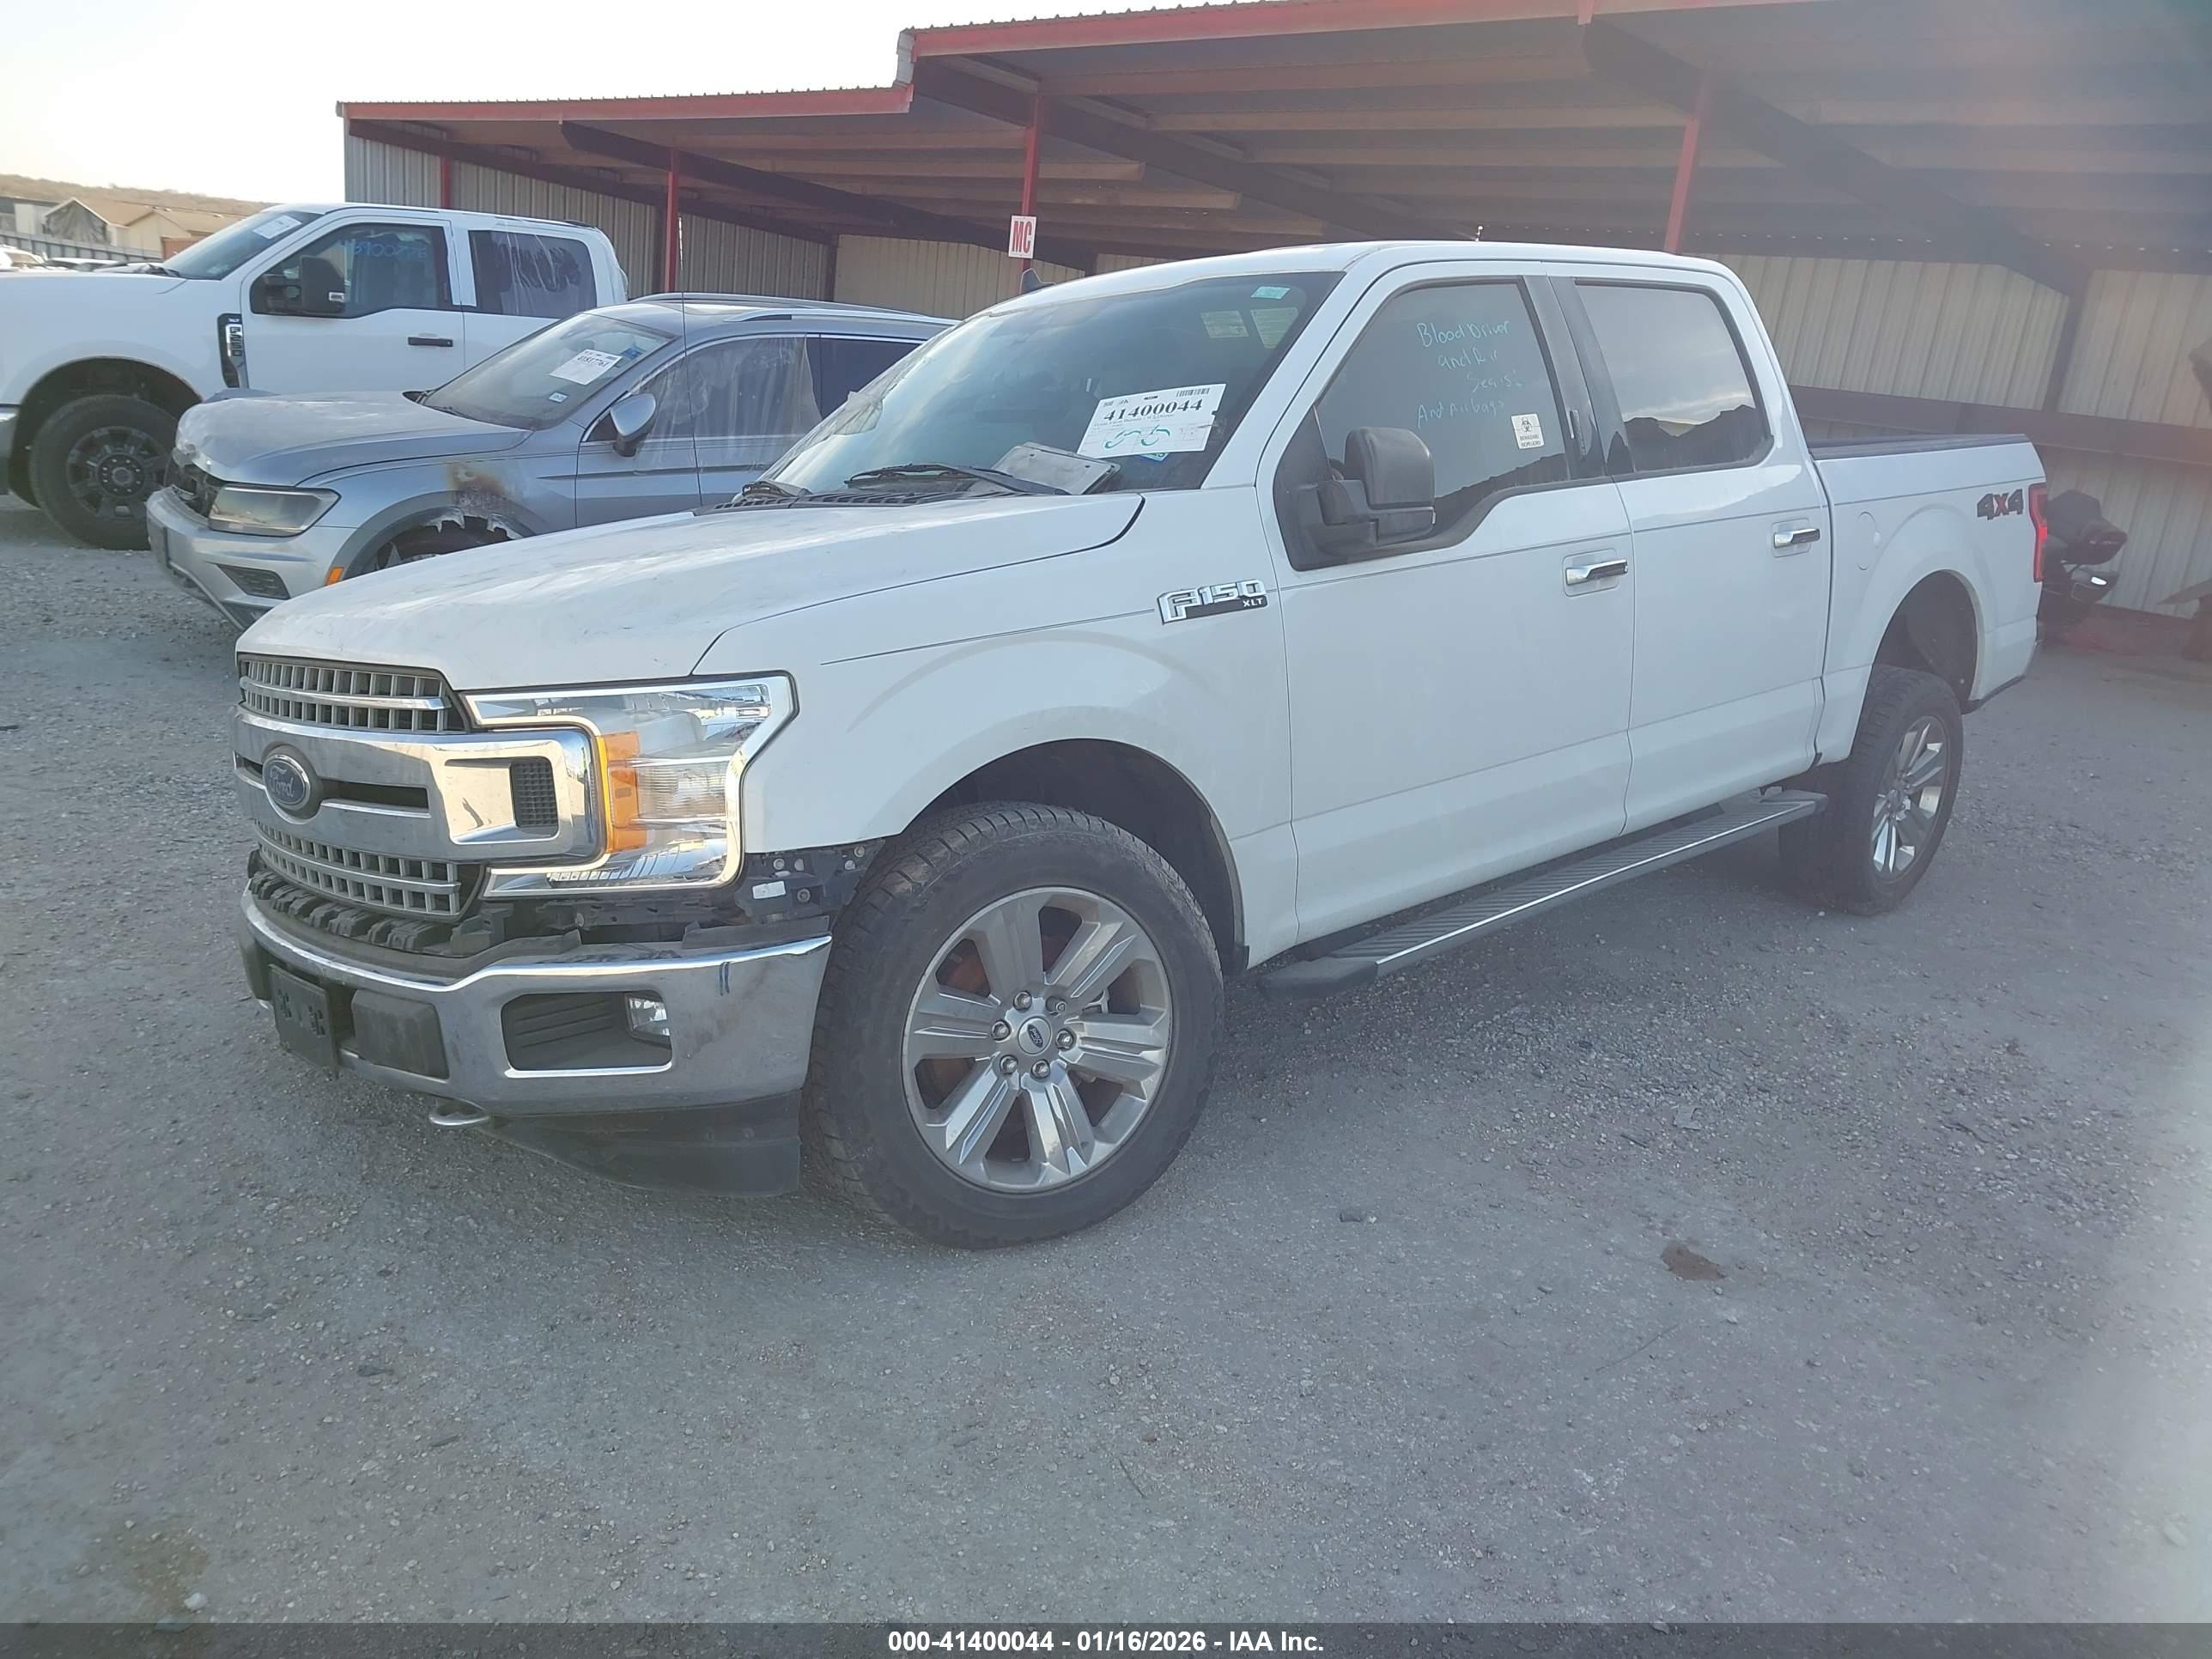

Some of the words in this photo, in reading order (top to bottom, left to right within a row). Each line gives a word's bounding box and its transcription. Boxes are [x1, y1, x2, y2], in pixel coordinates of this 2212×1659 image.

[1012, 220, 1033, 254] MC
[1417, 323, 1465, 347] Blood
[1467, 320, 1510, 338] Driver
[1103, 398, 1203, 421] 41400044
[1158, 580, 1267, 623] F150
[1242, 598, 1264, 607] XLT
[269, 765, 295, 798] Ford
